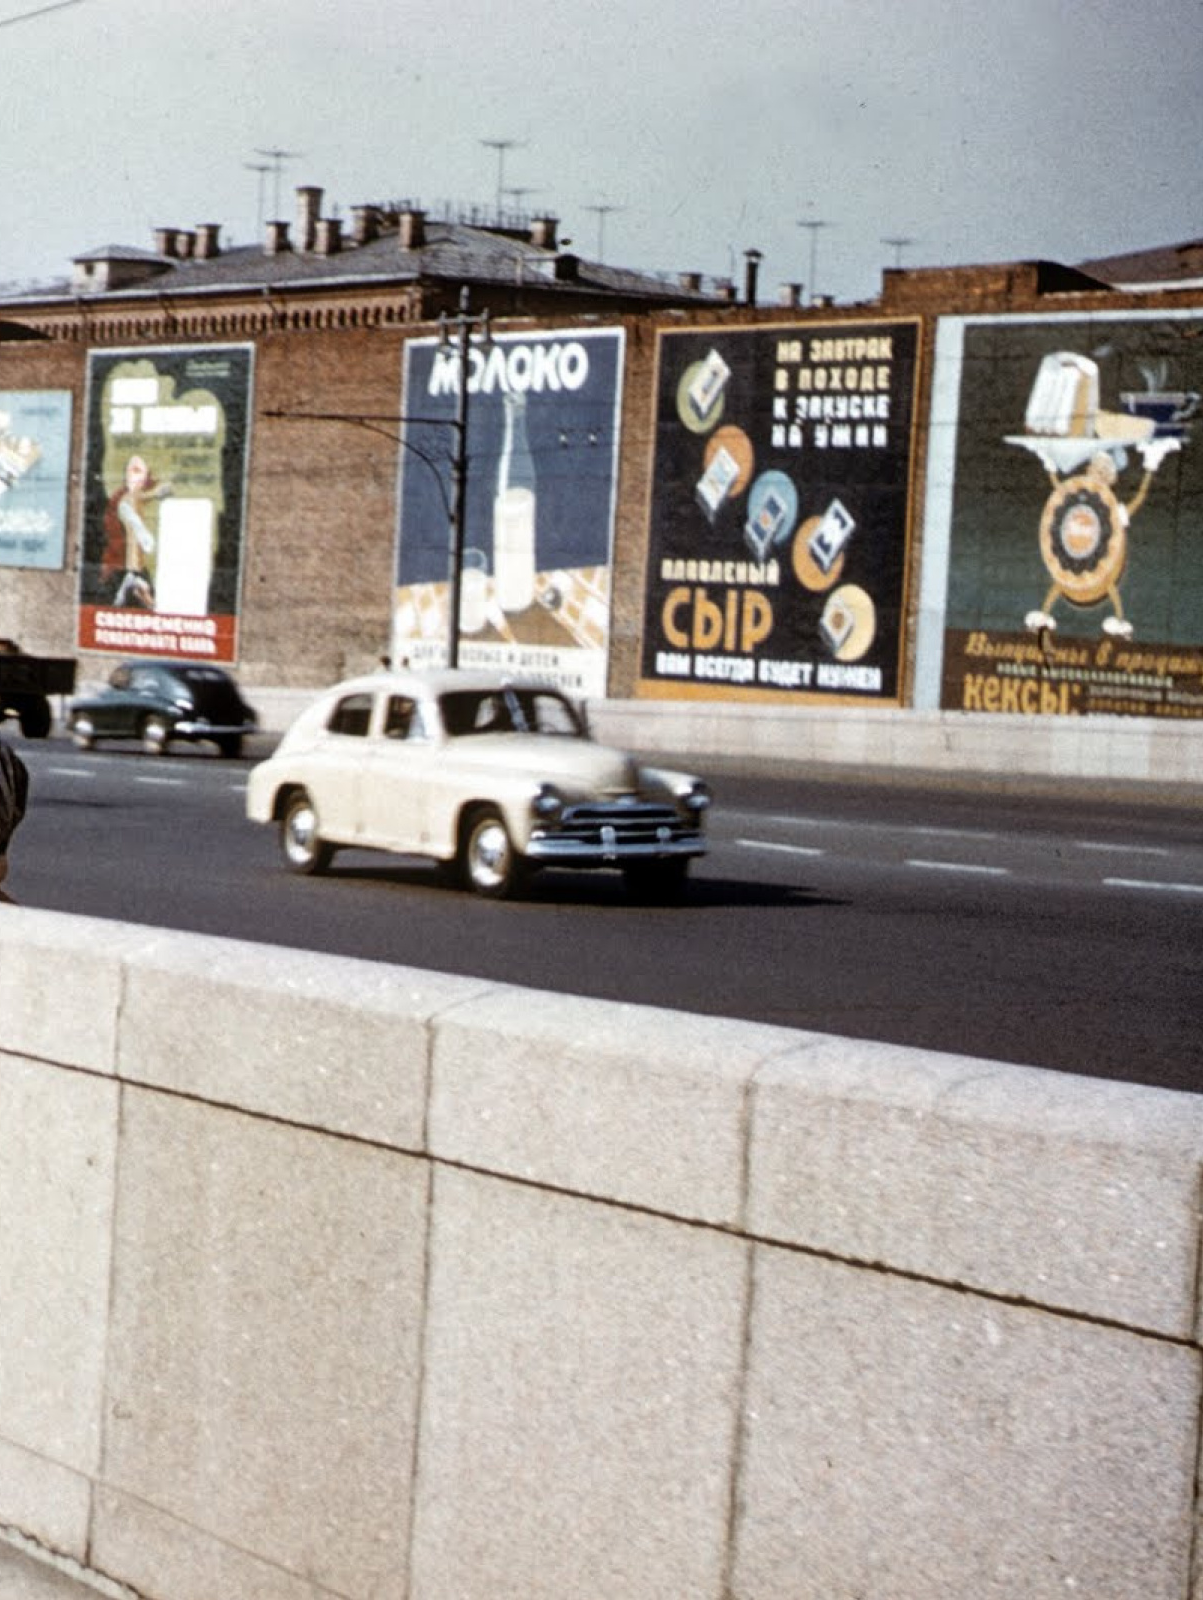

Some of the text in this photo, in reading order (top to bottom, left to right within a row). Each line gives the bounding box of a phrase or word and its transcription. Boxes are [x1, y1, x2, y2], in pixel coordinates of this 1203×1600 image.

[777, 336, 893, 362] НА ЗАВТРАК
[428, 342, 589, 397] МОЛОКО
[775, 365, 891, 392] В ПОХОДЕ
[773, 394, 890, 419] К ЗАКУСКЕ
[772, 423, 888, 448] НА УЖИН
[662, 586, 774, 652] СЫР
[655, 651, 882, 692] ВАМ ВСЕГДА БУДЕТ НУЖЕН
